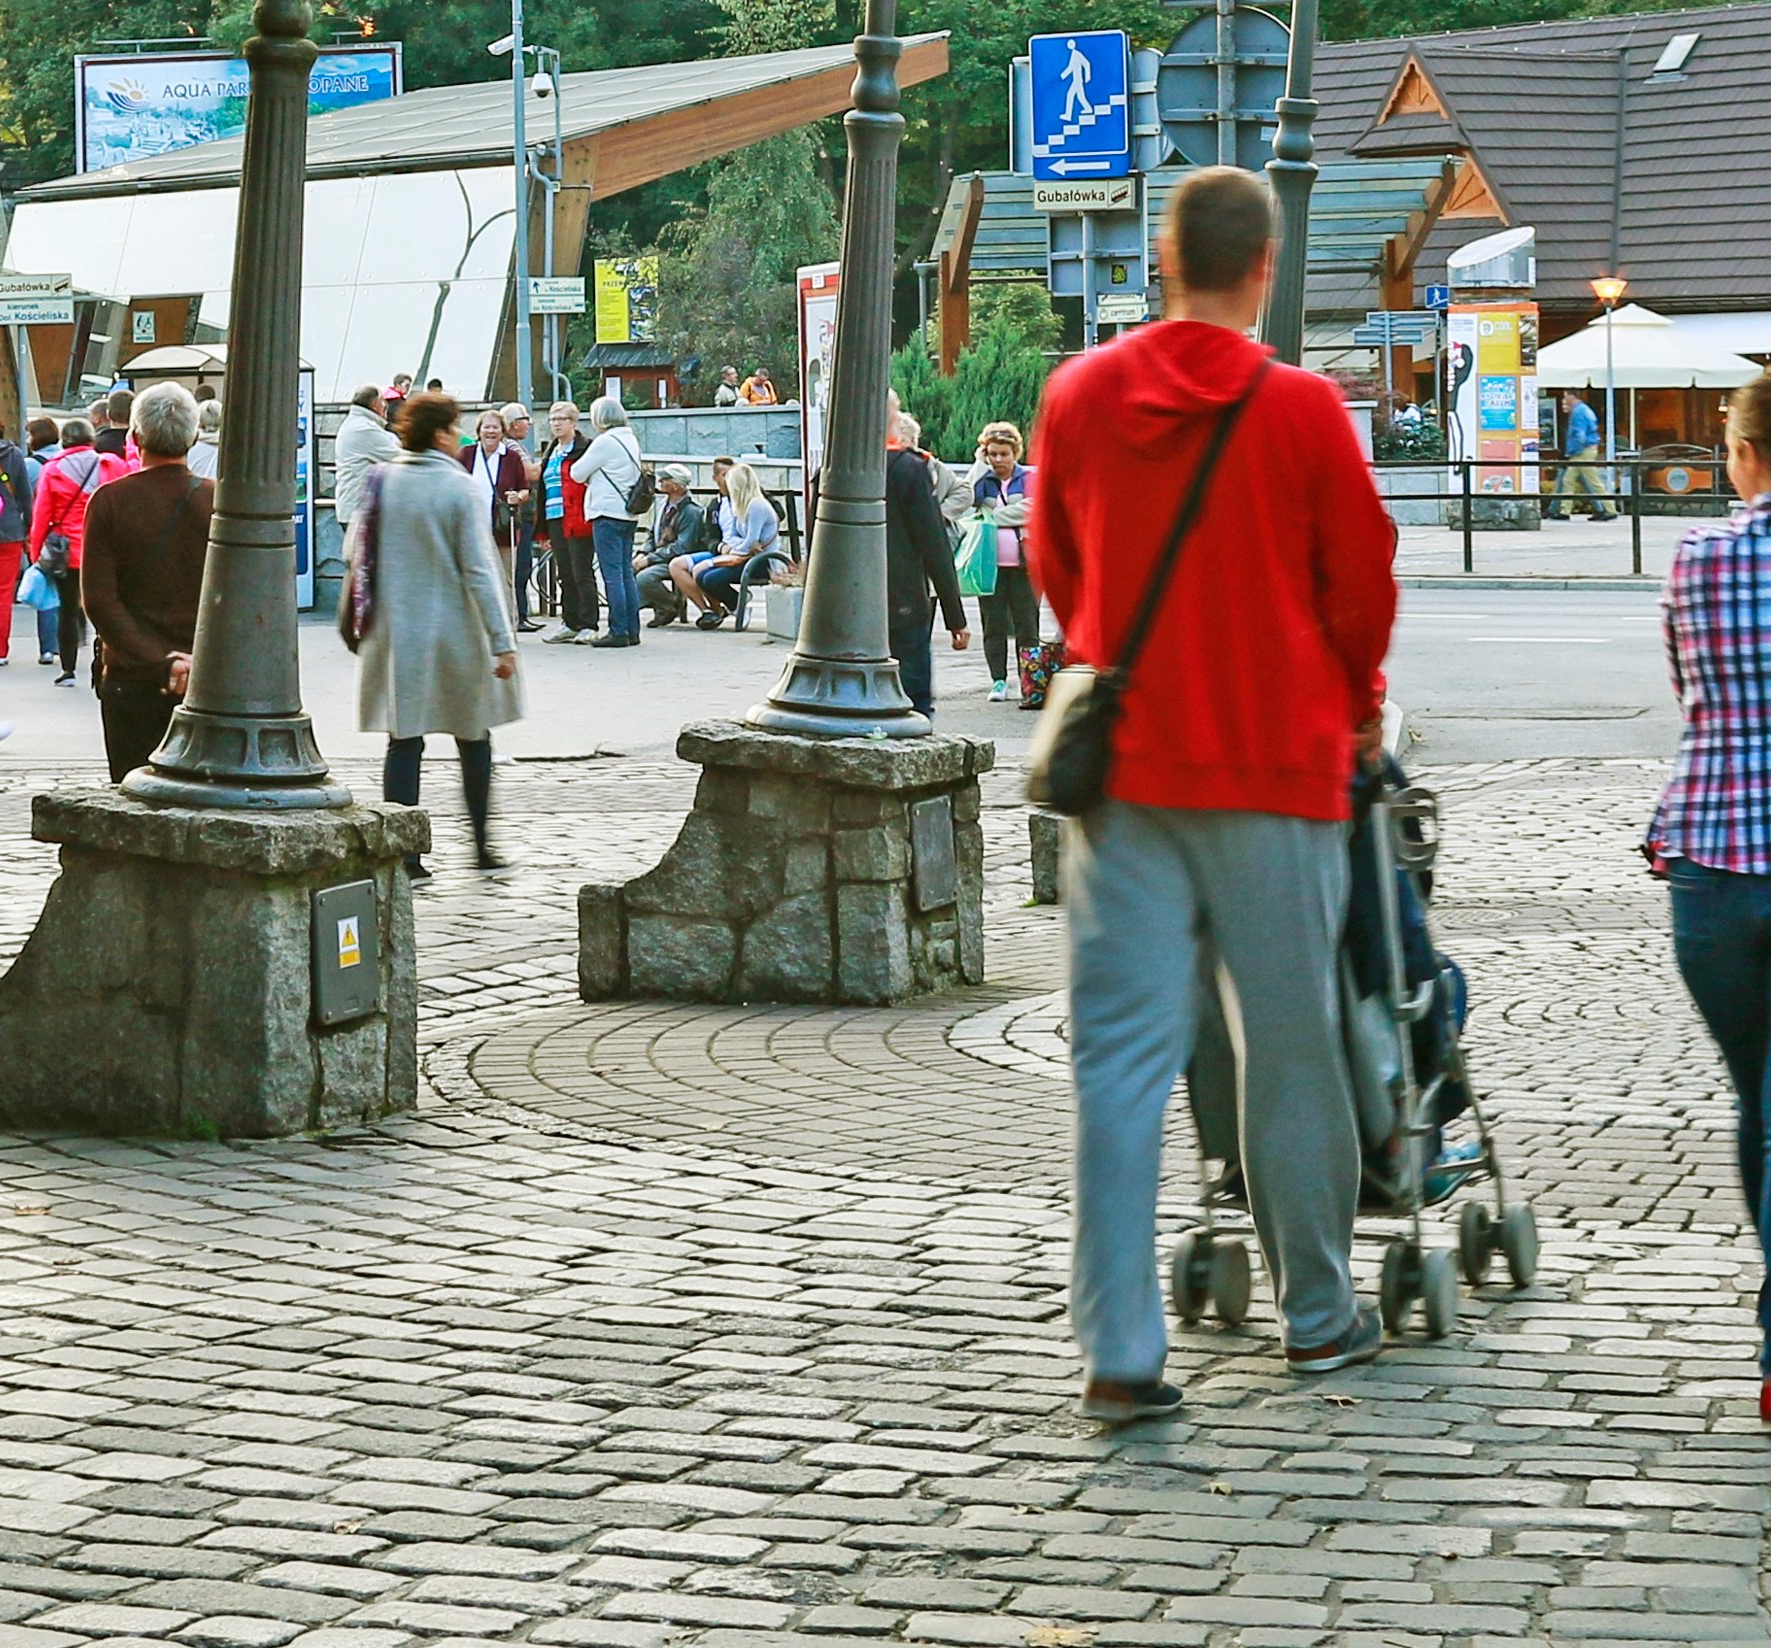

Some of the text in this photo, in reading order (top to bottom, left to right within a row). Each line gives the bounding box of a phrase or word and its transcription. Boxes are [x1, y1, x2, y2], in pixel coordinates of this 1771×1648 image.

[161, 74, 369, 99] AQUA PAR OPANE
[1037, 189, 1106, 203] Gubałówka
[15, 311, 69, 320] Kościeliska
